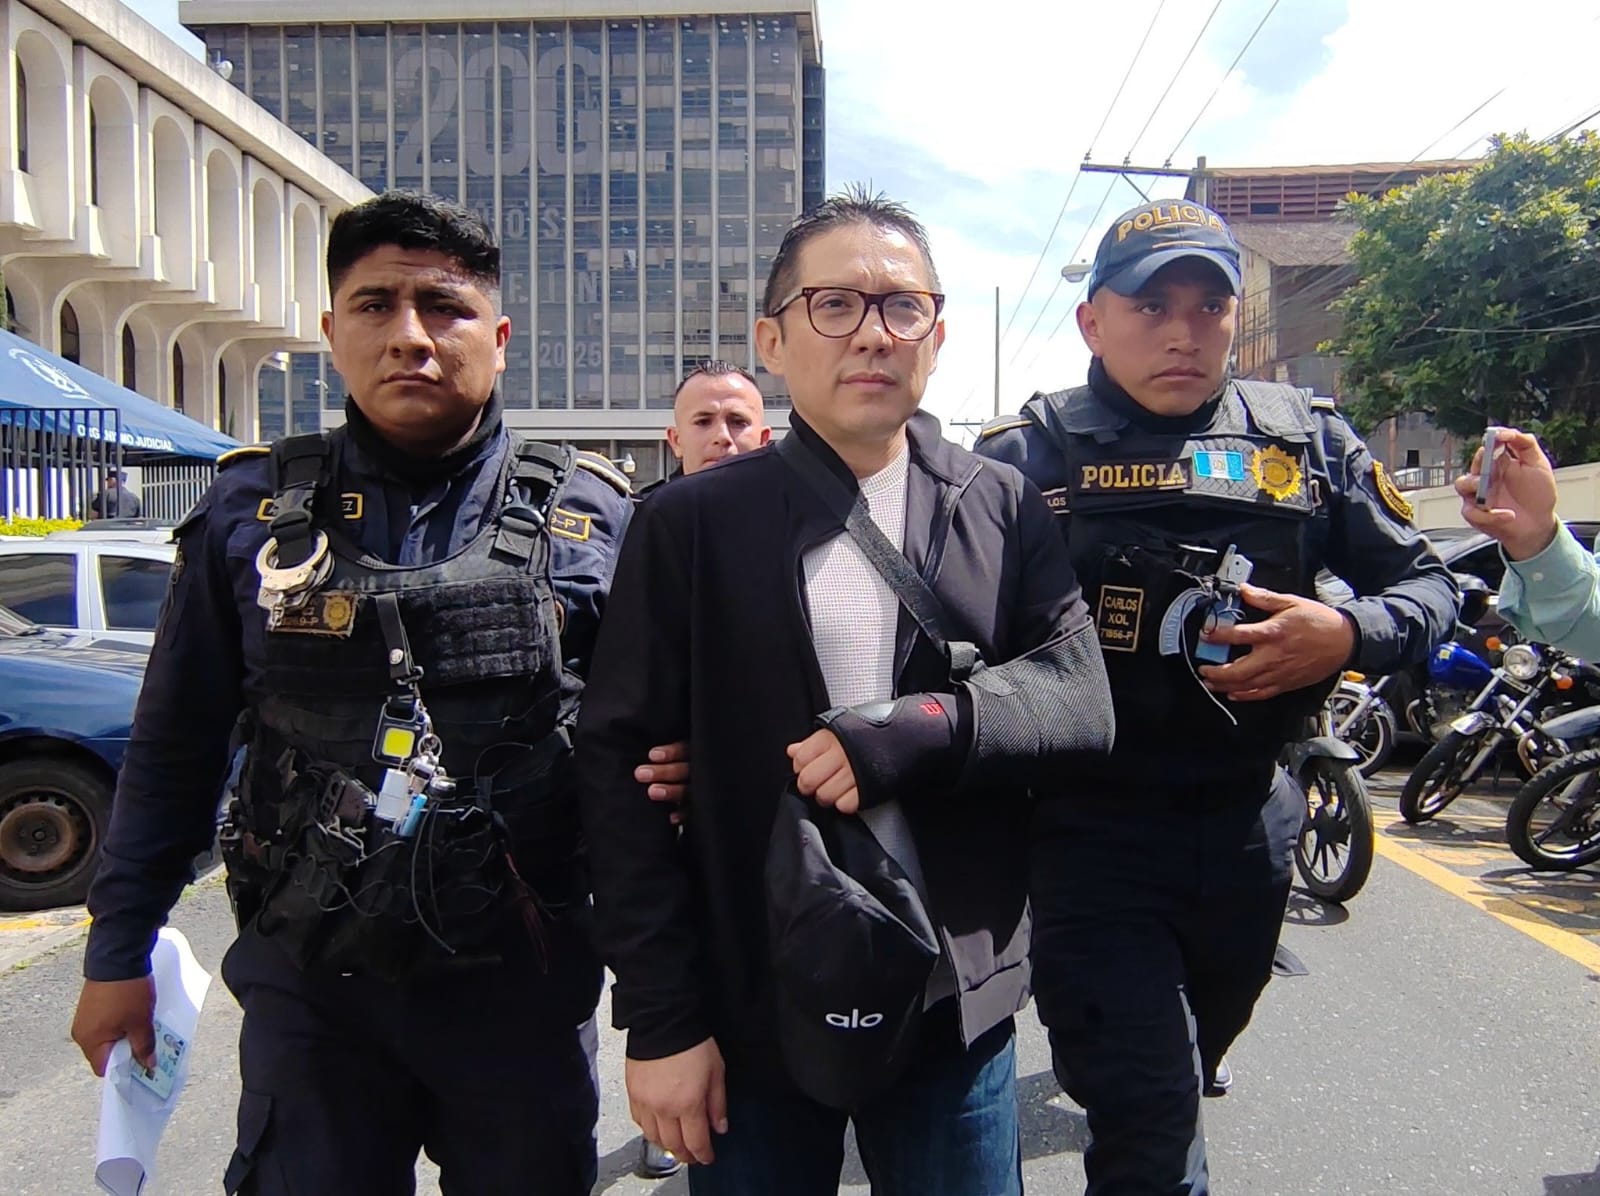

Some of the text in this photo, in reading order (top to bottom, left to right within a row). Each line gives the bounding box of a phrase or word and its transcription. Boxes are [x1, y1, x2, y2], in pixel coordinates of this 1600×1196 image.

[1116, 204, 1225, 243] POLICIA
[539, 341, 602, 368] 2025
[1081, 462, 1186, 489] POLICIA
[1104, 595, 1138, 613] CARLOS
[1107, 611, 1130, 627] XOL
[825, 1008, 884, 1029] alo
